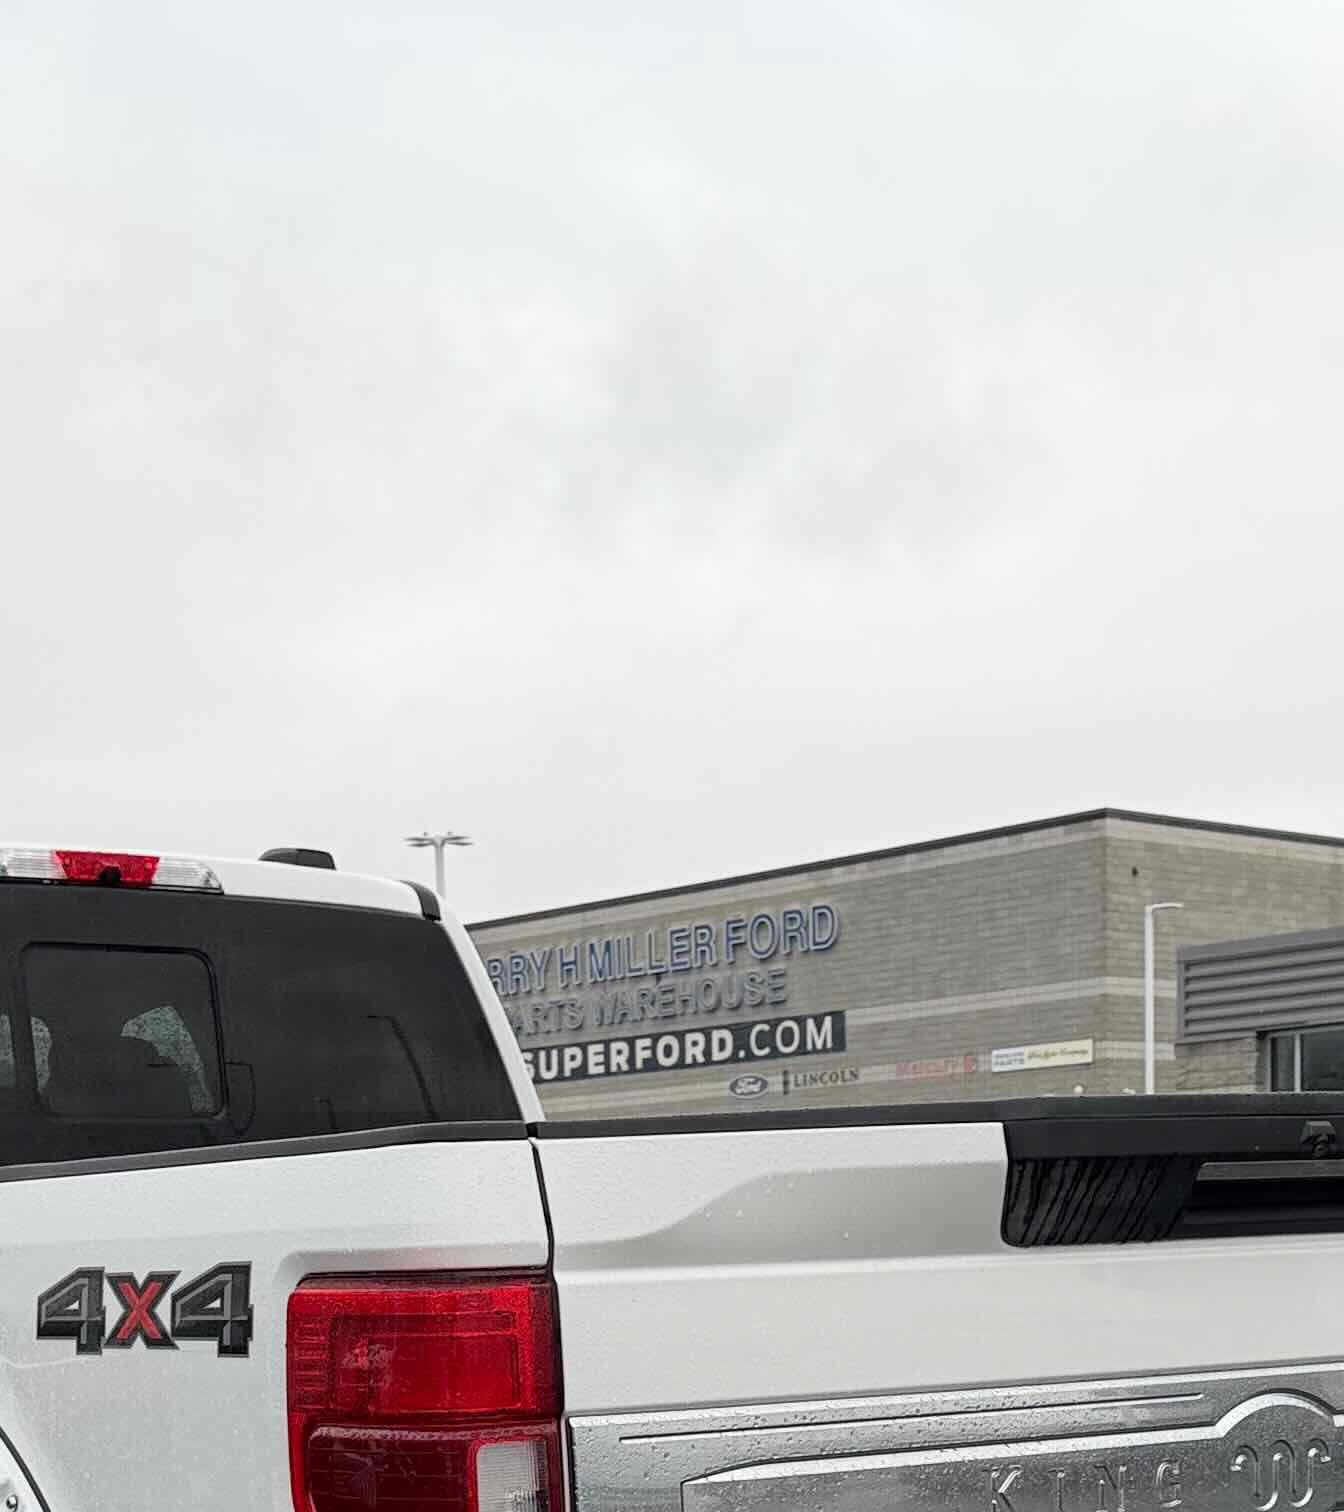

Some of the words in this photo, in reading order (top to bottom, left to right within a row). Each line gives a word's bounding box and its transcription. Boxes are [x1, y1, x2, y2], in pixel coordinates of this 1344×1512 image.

[487, 946, 552, 996] RRY
[559, 943, 582, 988] H
[588, 923, 717, 985] MILLER
[724, 904, 840, 965] FORD
[506, 1000, 585, 1037] ARTS
[593, 967, 788, 1026] WAREHOUSE
[522, 1014, 833, 1083] SUPERFORD.COM
[793, 1069, 859, 1090] LINCOLN
